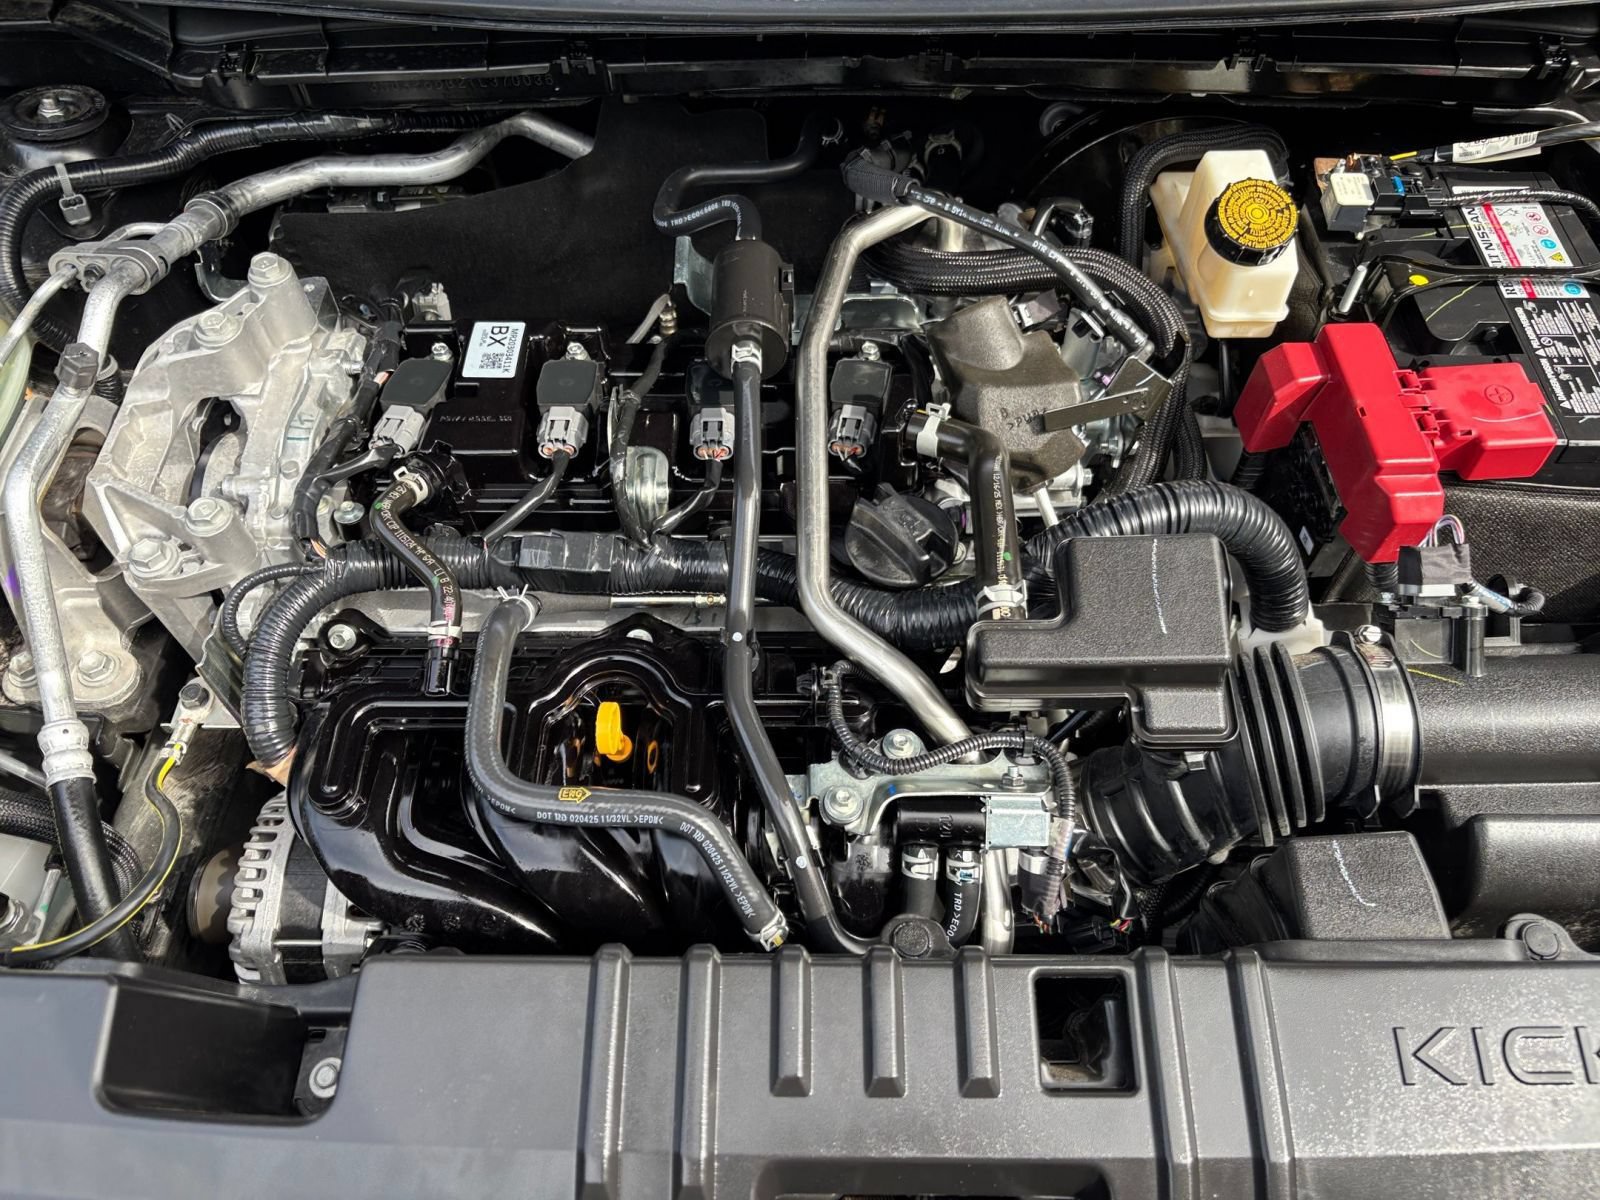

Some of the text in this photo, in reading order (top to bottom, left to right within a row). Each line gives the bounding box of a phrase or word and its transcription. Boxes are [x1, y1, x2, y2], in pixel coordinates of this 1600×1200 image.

[1465, 206, 1495, 251] NISSAN
[487, 326, 509, 347] BX
[993, 473, 1001, 498] 12/16/25
[537, 812, 551, 820] DOT
[570, 814, 599, 824] 020425
[679, 821, 695, 835] DOT
[701, 839, 724, 866] 020425
